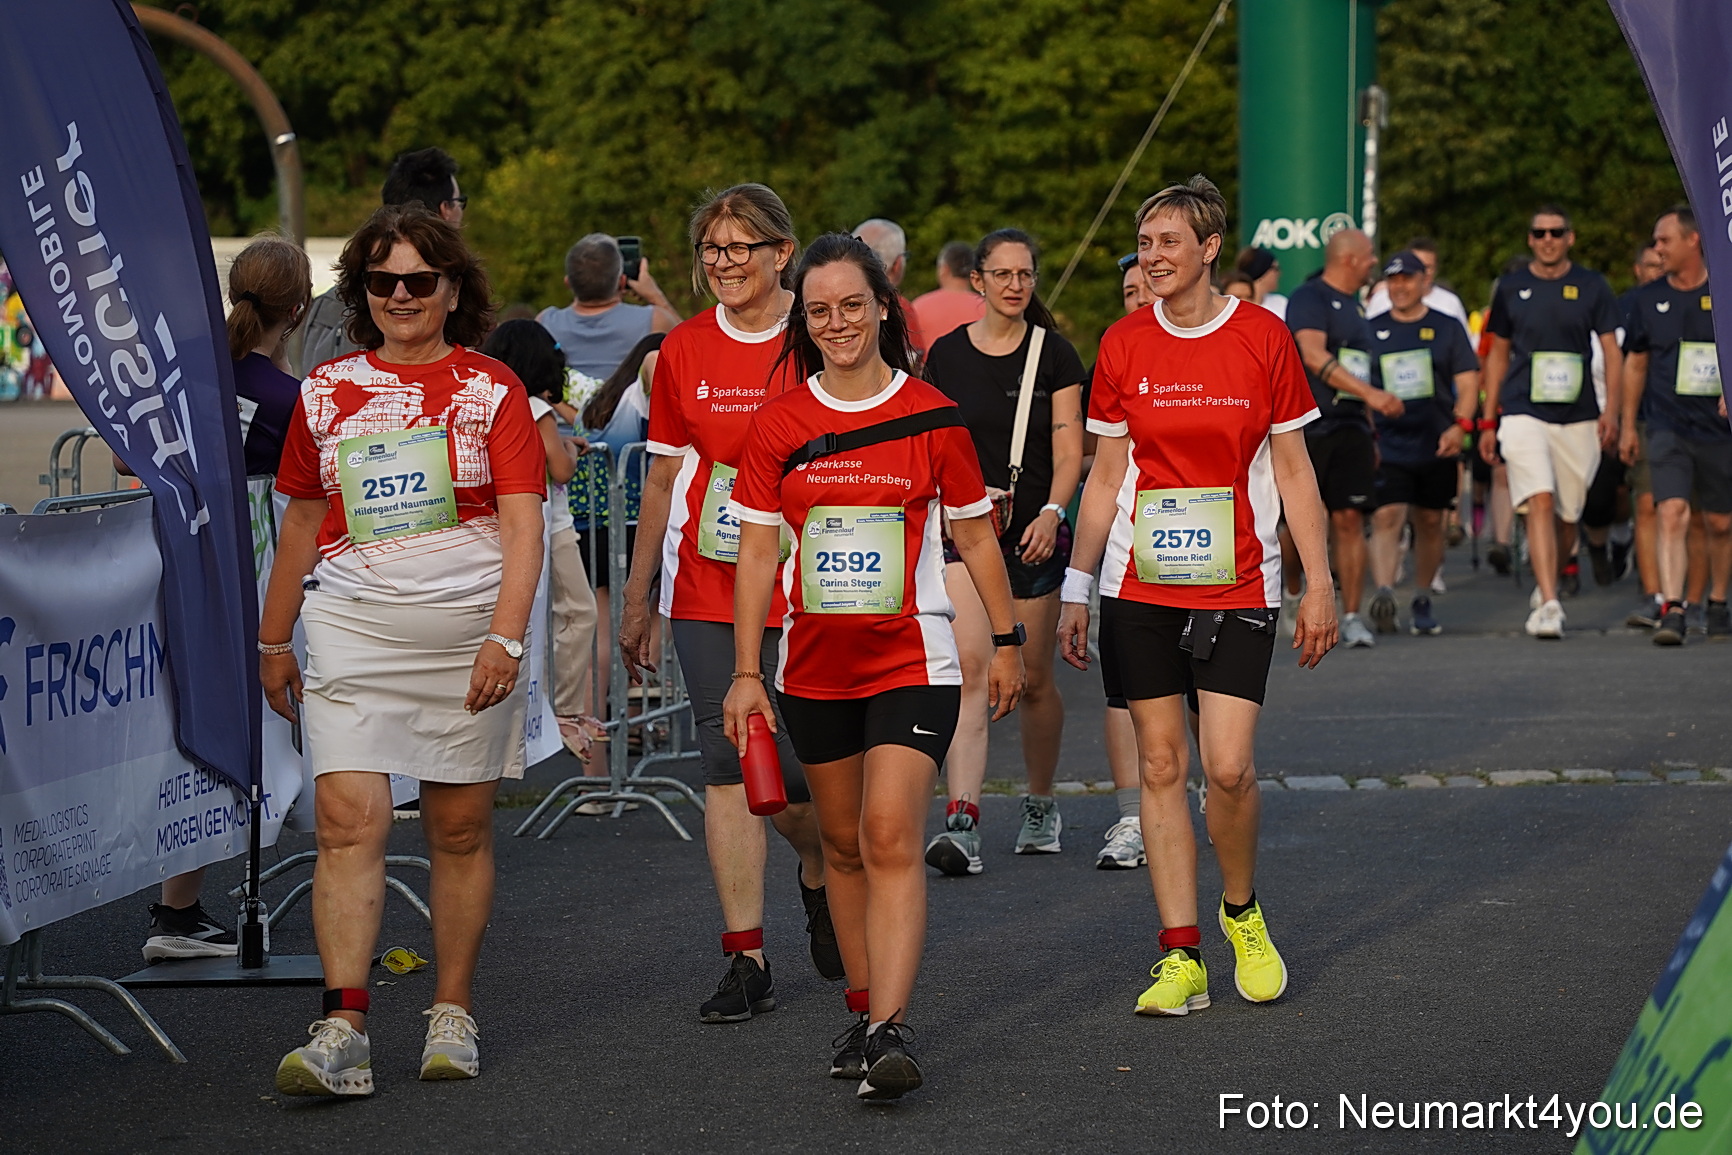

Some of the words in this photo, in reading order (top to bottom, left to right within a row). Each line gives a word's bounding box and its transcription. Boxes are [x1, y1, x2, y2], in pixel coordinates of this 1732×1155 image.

[1250, 217, 1321, 250] AOK
[712, 386, 766, 400] Sparkasse
[1153, 382, 1204, 395] Sparkasse
[1152, 396, 1251, 409] Neumarkt-Parsberg
[809, 459, 863, 472] Sparkasse
[361, 471, 428, 500] 2572
[806, 472, 912, 490] Neumarkt-Parsberg
[353, 501, 399, 517] Hildegard
[400, 495, 447, 510] Naumann
[1151, 529, 1212, 549] 2579
[815, 551, 882, 573] 2592
[1156, 553, 1189, 562] Simone
[1190, 553, 1212, 562] Riedl
[819, 578, 849, 588] Carina
[850, 578, 882, 589] Steger
[159, 771, 191, 810] HEUTE
[156, 811, 204, 856] MORGEN
[13, 837, 72, 874] CORPORATE
[72, 829, 97, 856] PRINT
[15, 865, 74, 903] CORPORATE
[75, 852, 112, 885] SIGNAGE
